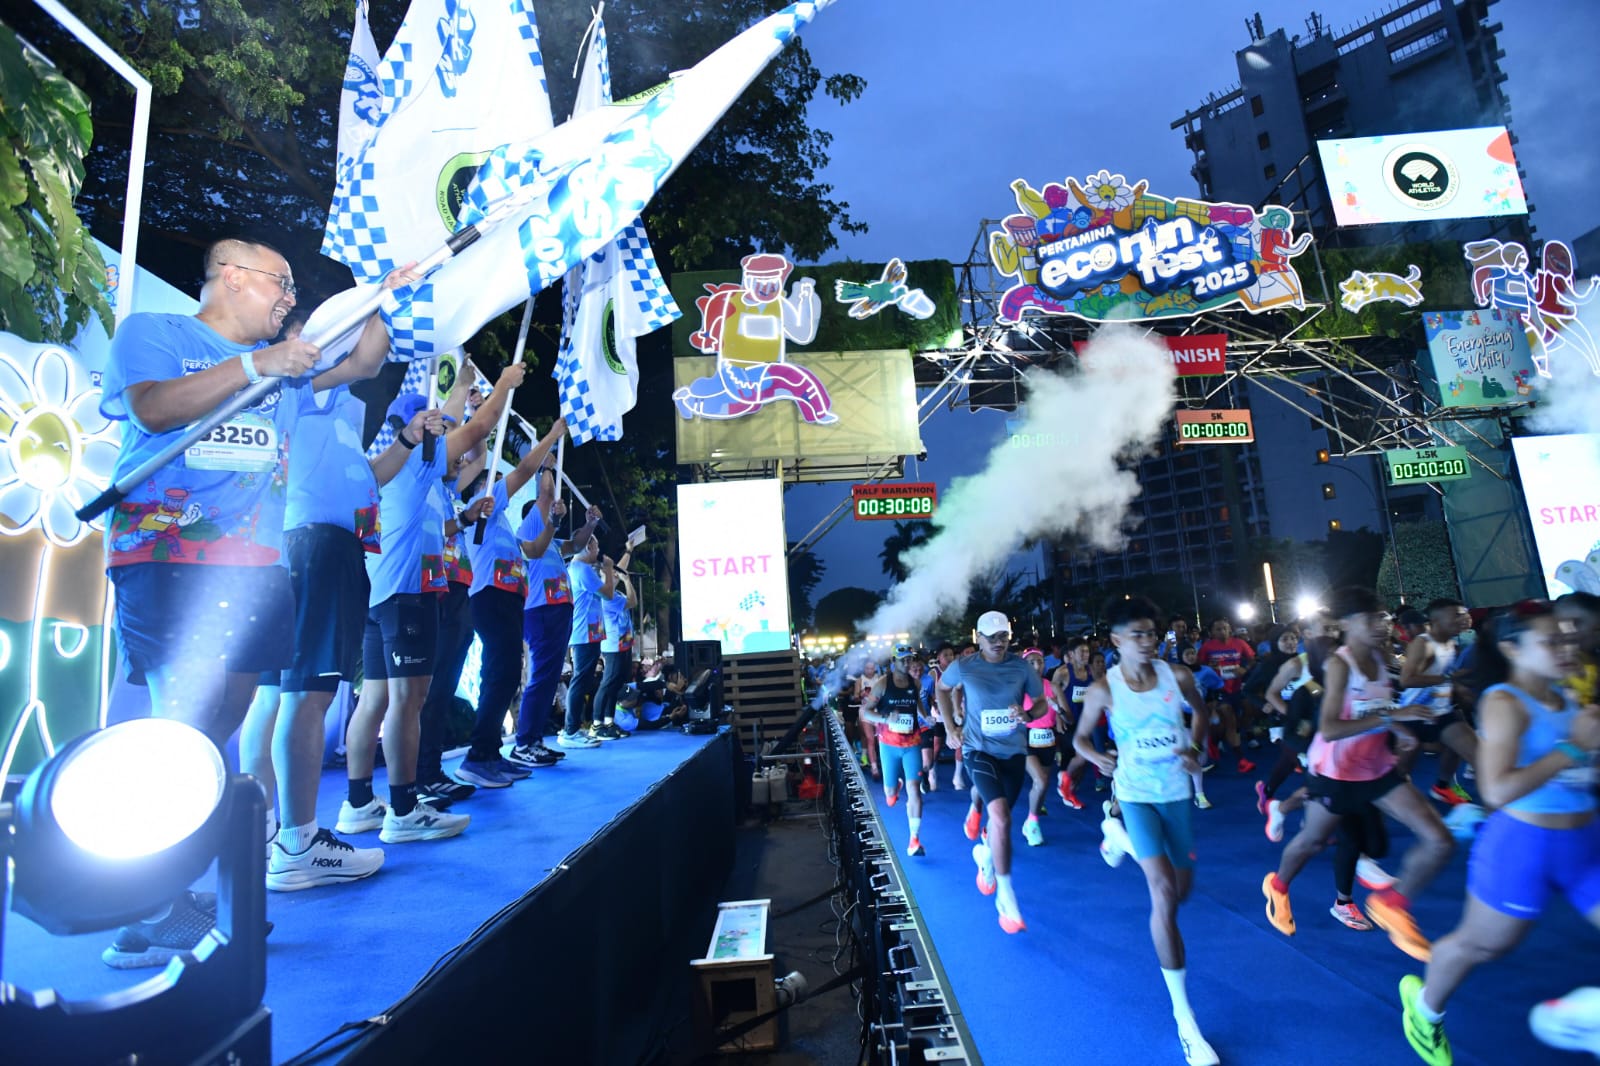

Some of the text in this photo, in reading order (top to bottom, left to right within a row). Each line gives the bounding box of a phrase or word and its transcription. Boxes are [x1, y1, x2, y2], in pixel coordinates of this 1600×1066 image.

[1039, 225, 1115, 257] PERTAMINA
[530, 216, 567, 288] 202
[1136, 229, 1223, 284] fest
[1193, 262, 1250, 293] 2025
[1446, 330, 1514, 356] Energizing
[1454, 349, 1507, 373] The Unity
[1210, 412, 1223, 420] 5K
[1182, 422, 1247, 438] 00:00:00
[1416, 450, 1438, 459] 1.5K
[1393, 460, 1464, 479] 00:00:00
[855, 486, 934, 496] HALF MARATHON
[858, 498, 931, 516] 00:30:08
[1540, 504, 1600, 525] STAR
[691, 554, 772, 577] START
[311, 857, 343, 868] HOKA
